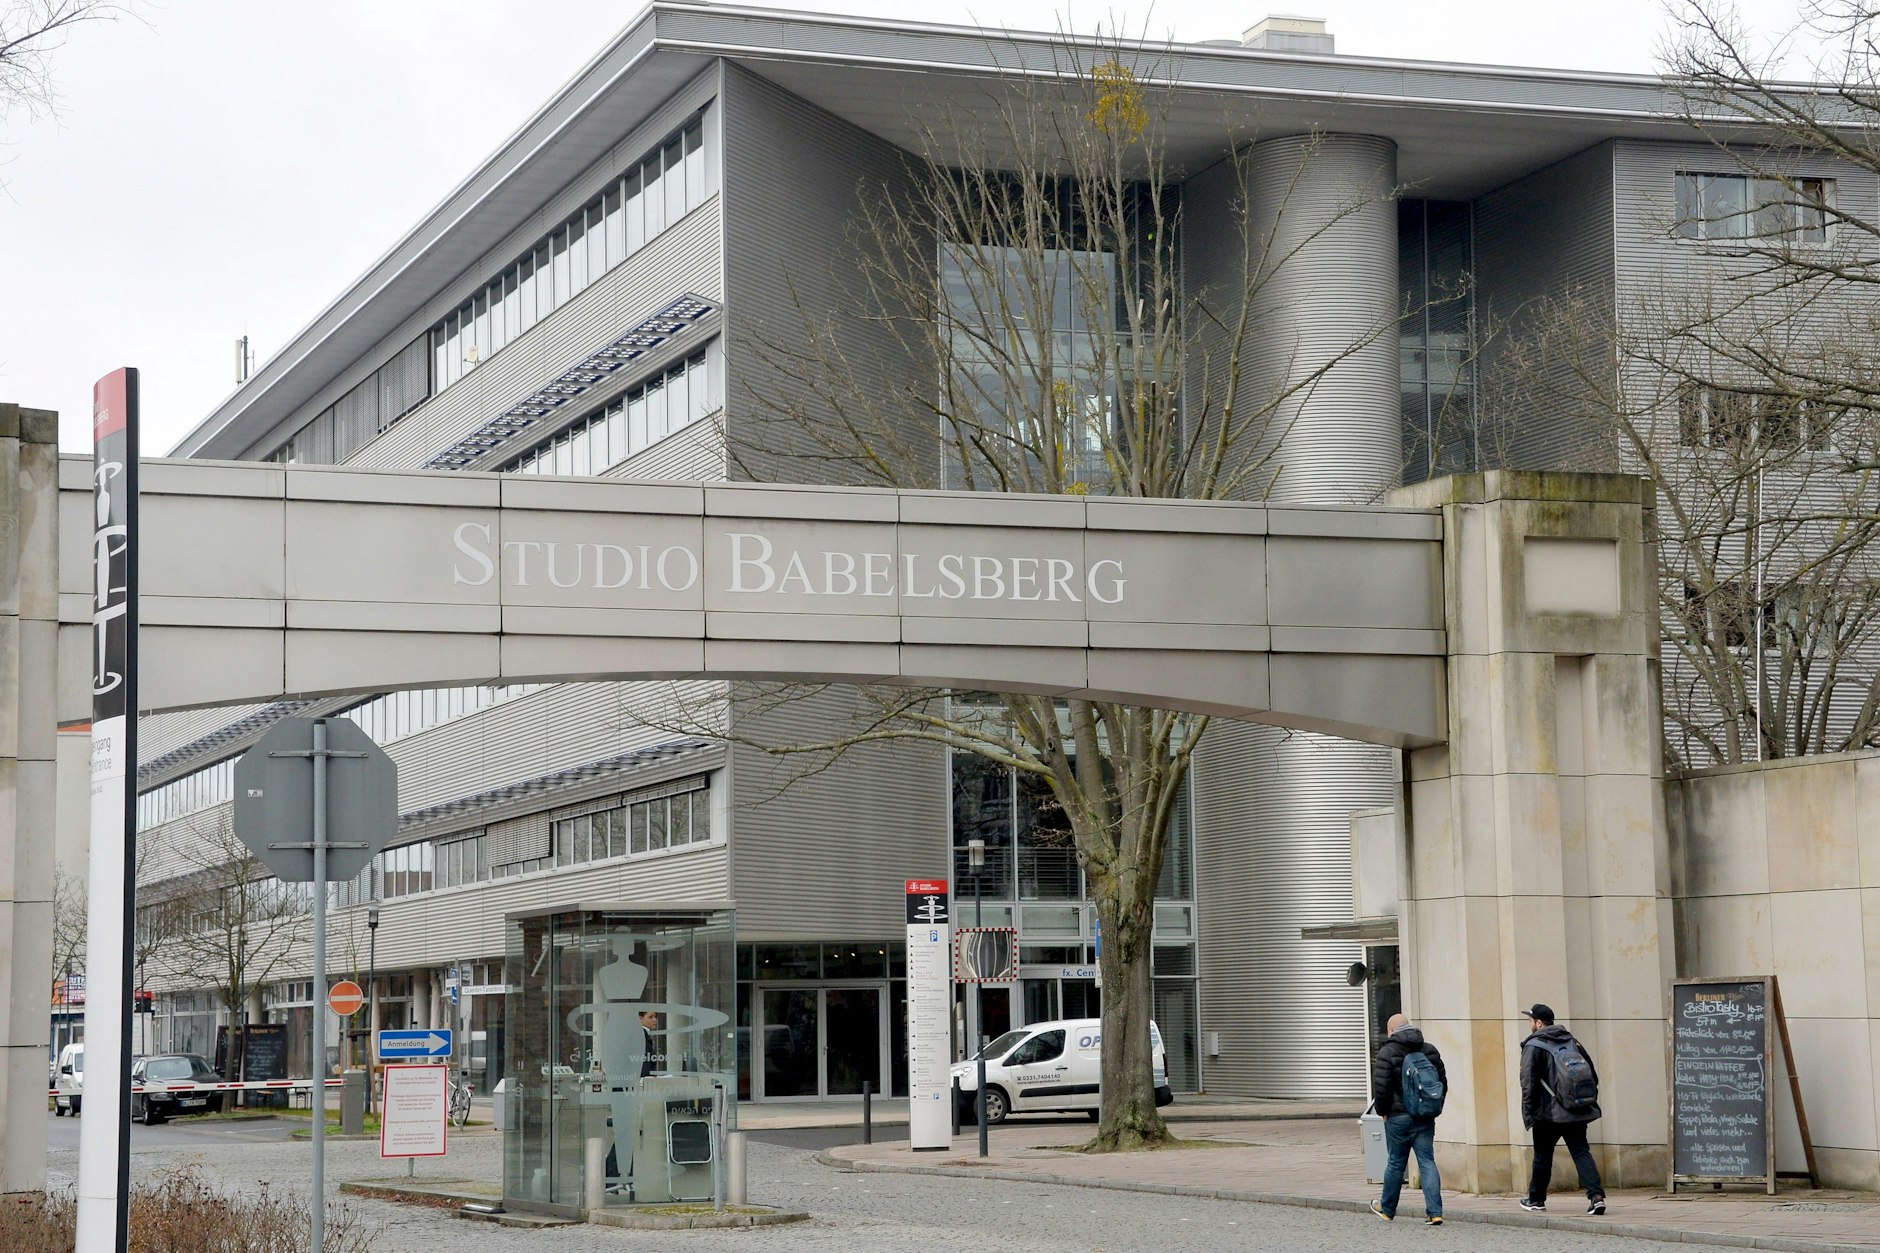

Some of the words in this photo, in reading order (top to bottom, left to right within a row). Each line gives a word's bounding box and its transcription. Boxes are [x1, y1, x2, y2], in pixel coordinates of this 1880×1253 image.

[1062, 968, 1073, 977] fx.
[1077, 968, 1096, 977] Cen
[1695, 992, 1725, 1001] BERLINER
[387, 1040, 425, 1048] Anmeldung
[1079, 1035, 1101, 1048] OP
[629, 1052, 687, 1063] welcoe!
